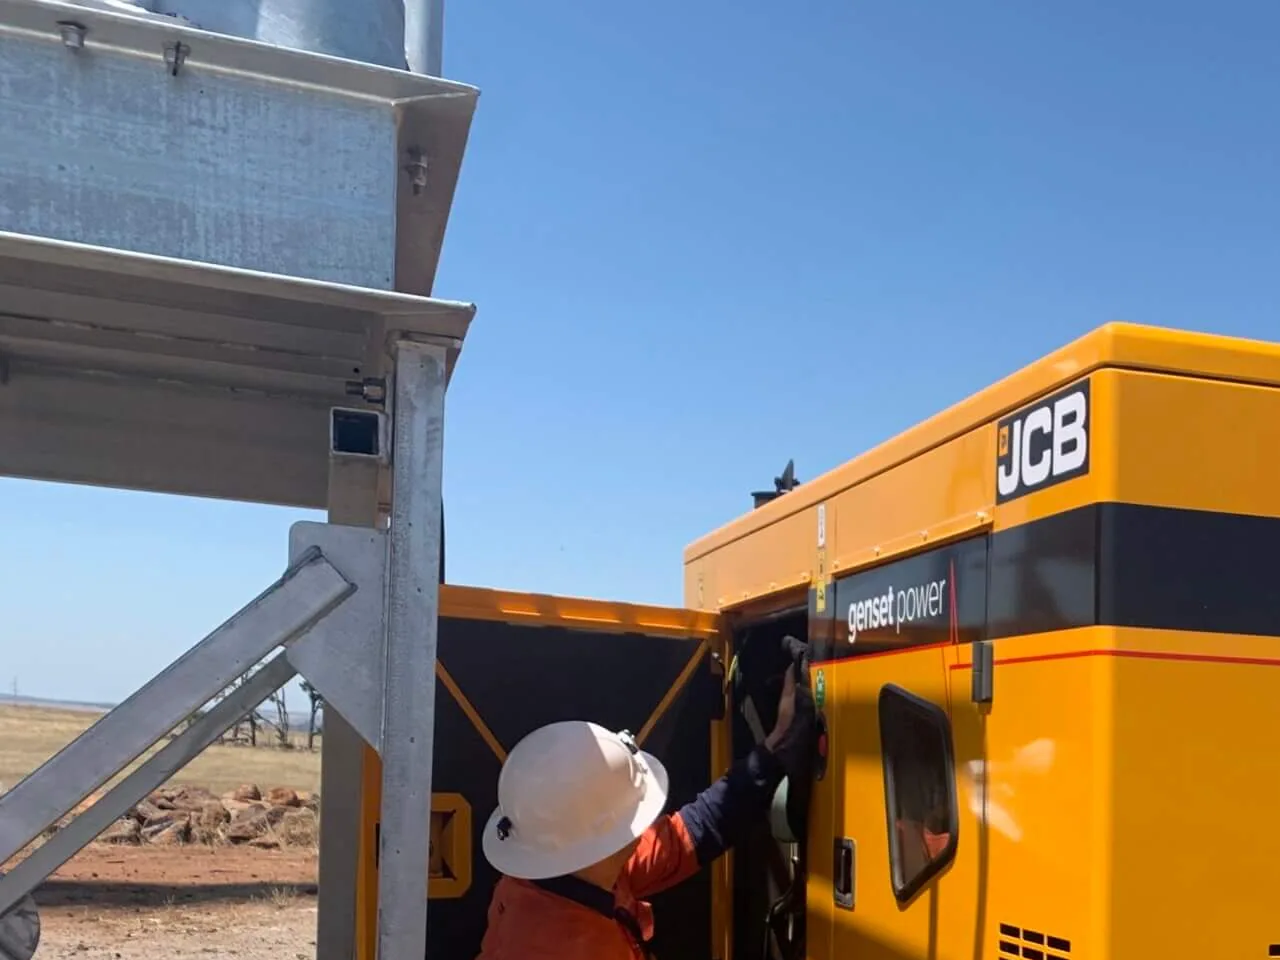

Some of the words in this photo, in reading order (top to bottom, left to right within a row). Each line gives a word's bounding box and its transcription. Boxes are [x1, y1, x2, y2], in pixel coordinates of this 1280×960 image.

[998, 391, 1087, 496] JCB
[848, 586, 894, 644] genset
[896, 579, 945, 634] power
